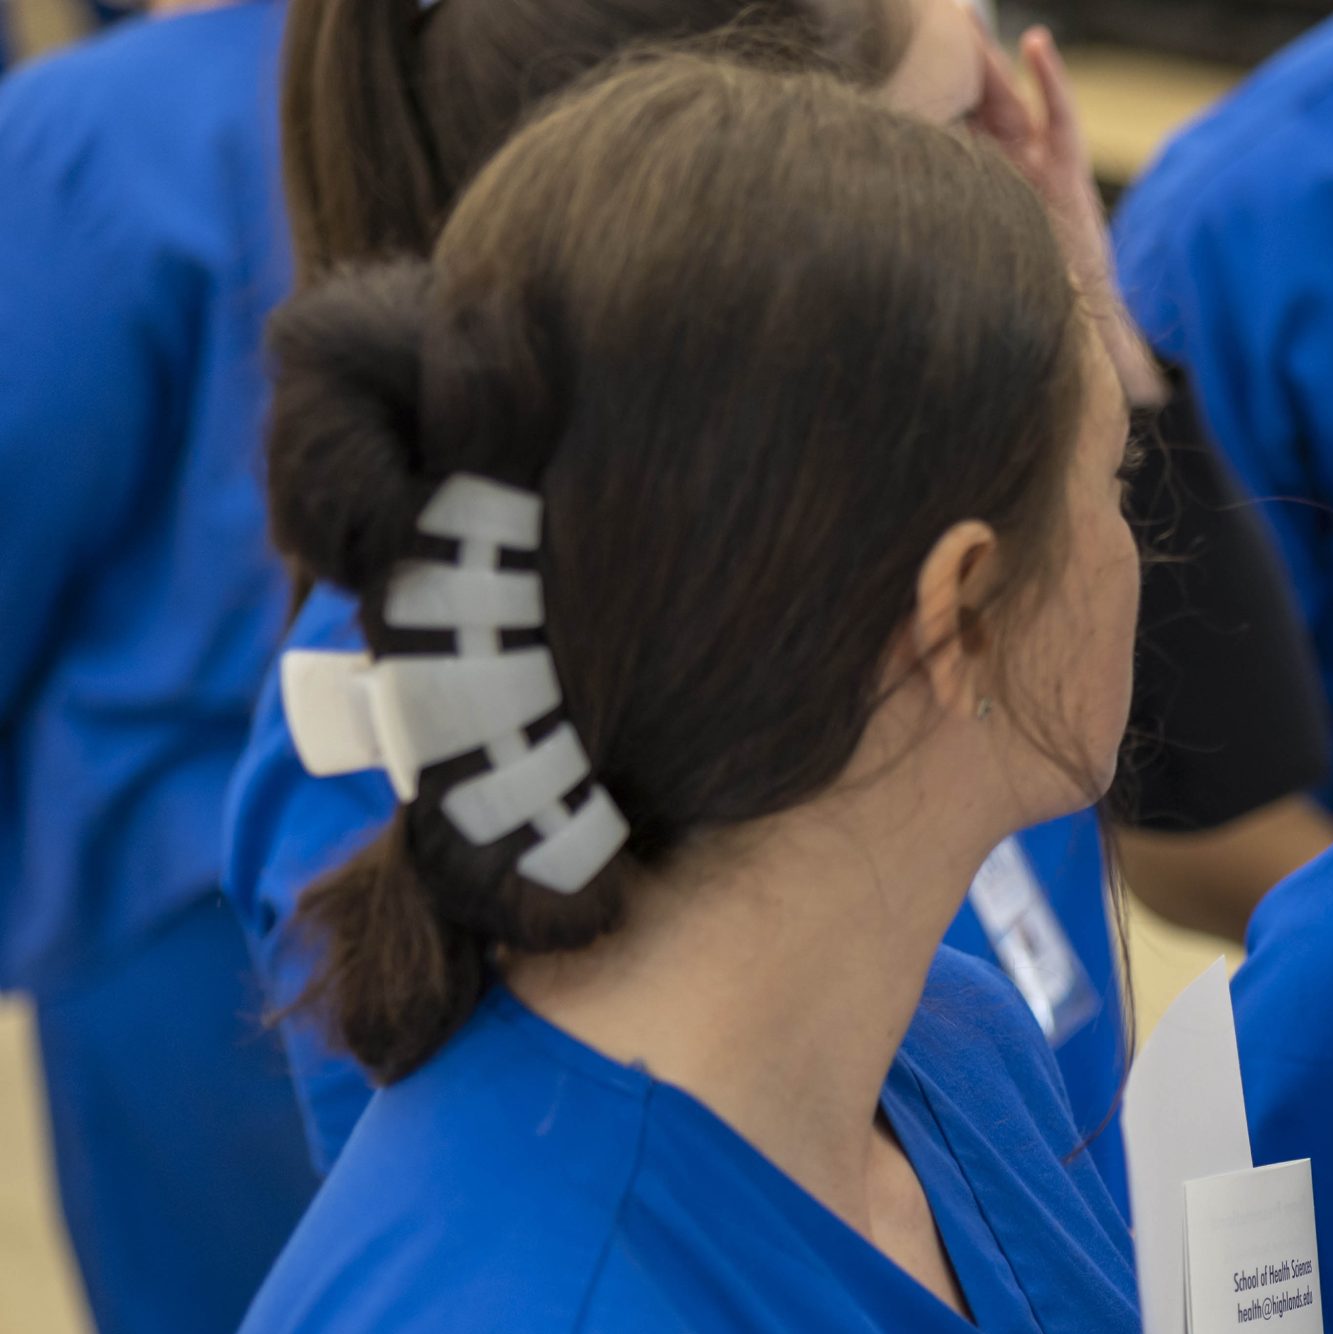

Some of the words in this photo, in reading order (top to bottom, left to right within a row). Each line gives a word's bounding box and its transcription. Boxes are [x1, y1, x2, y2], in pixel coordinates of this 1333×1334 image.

[1234, 1269, 1259, 1292] School
[1260, 1265, 1267, 1286] of
[1269, 1260, 1290, 1284] Health
[1291, 1259, 1312, 1278] Sciences
[1237, 1284, 1313, 1323] health@highlands.edu
